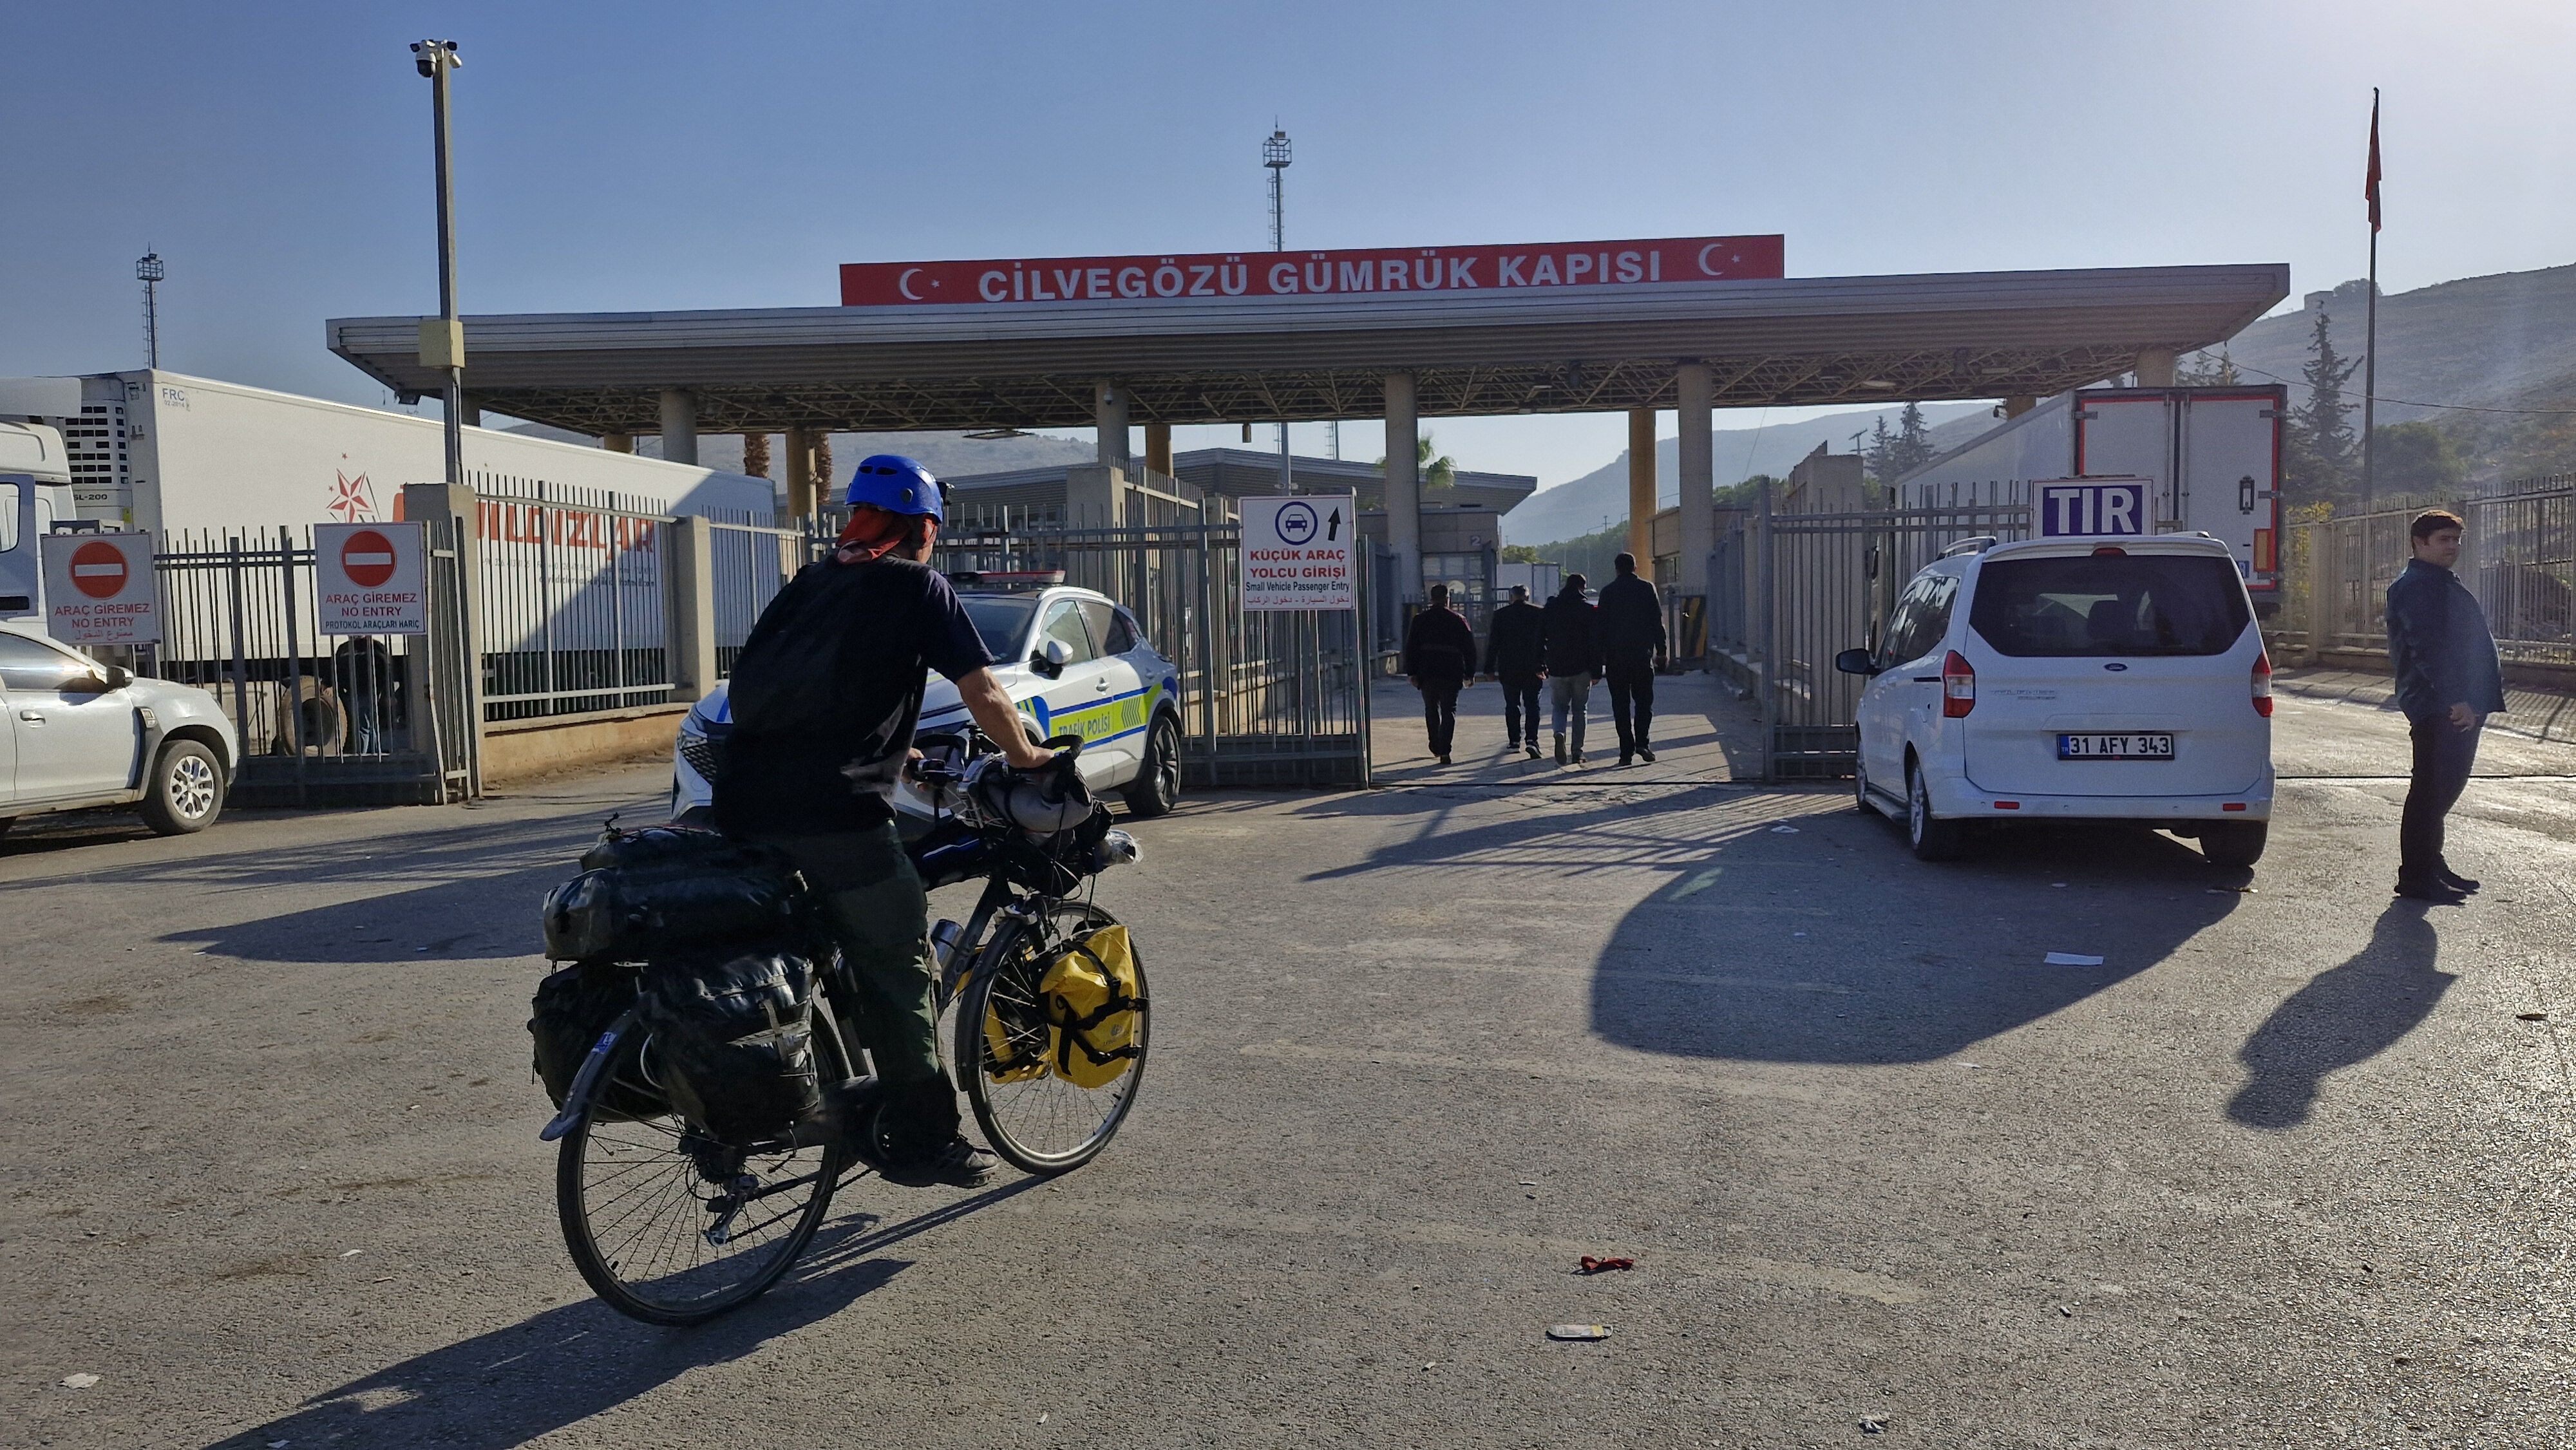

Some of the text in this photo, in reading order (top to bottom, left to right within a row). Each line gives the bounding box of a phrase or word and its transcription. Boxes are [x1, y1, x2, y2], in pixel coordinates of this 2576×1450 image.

[978, 250, 1661, 302] CİLVEGÖZÜ GÜMRÜK KAPISI
[162, 388, 185, 401] FRC
[2047, 487, 2136, 535] TIR
[1471, 536, 1481, 547] 2
[1250, 548, 1345, 563] KÜÇÜK ARAÇ
[1250, 565, 1346, 580] YOLCU GİRİŞİ
[1246, 581, 1350, 593] Small Vehicle Passenger Entry
[325, 591, 417, 605] ARAÇ GİREMEZ
[1273, 596, 1293, 605] دخول
[1302, 595, 1327, 605] السيارة
[1329, 595, 1349, 605] دخول
[55, 602, 150, 617] ARAÇ GİREMEZ
[341, 607, 402, 617] NO ENTRY
[72, 617, 134, 628] NO ENTRY
[325, 617, 419, 630] PROTOKOL ARAÇLARI HARİÇ
[1087, 711, 1110, 736] POLİSİ
[2070, 737, 2170, 754] 31 AFY 343
